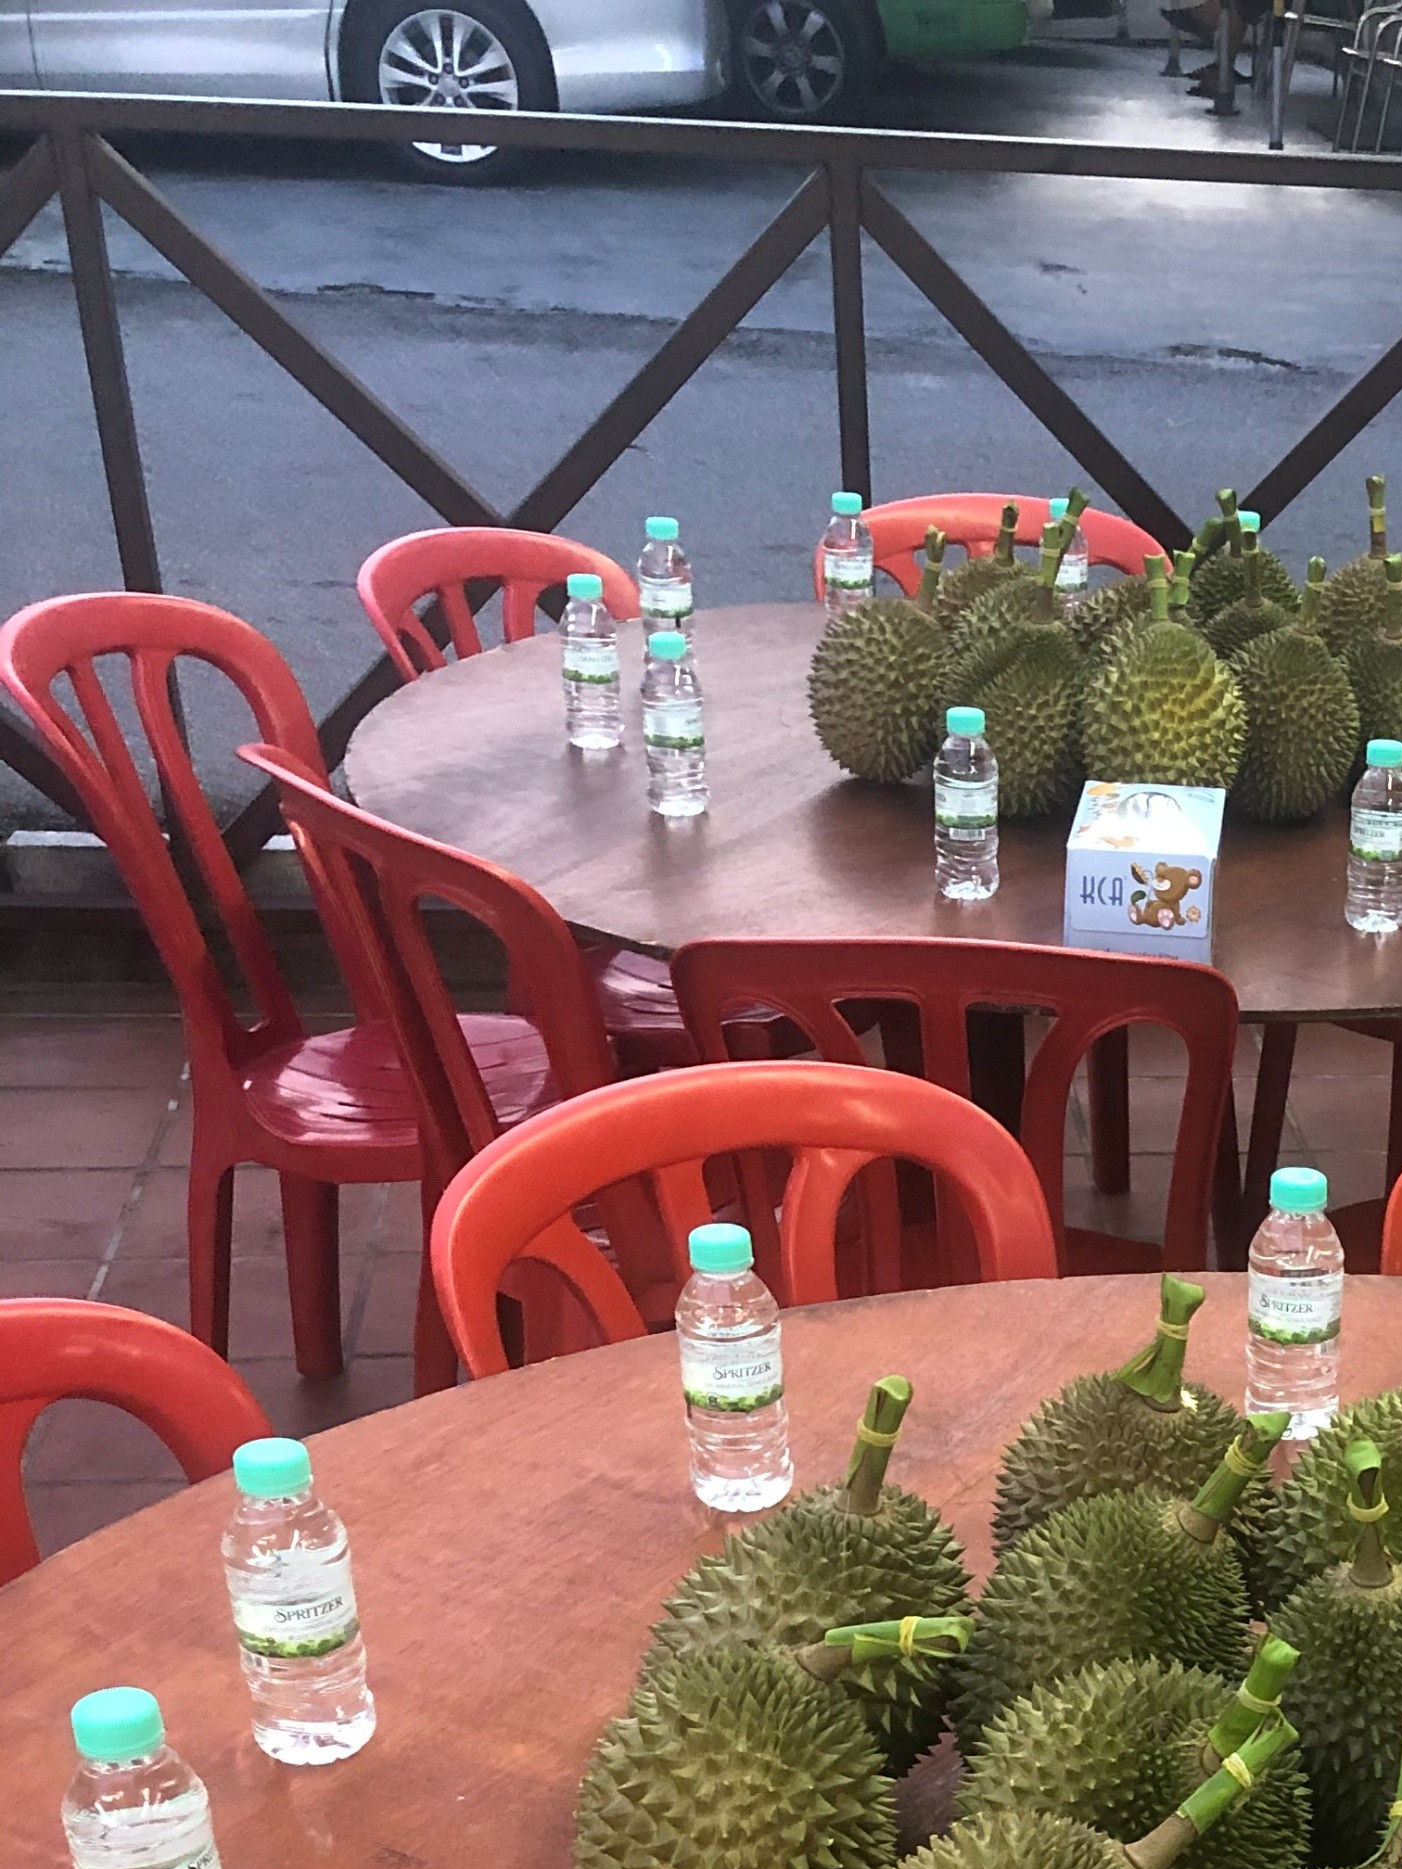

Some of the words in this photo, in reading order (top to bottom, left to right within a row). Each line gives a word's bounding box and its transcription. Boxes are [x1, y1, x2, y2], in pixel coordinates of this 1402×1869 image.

[1079, 875, 1124, 907] KCA
[712, 1361, 772, 1381] SPRITZER
[274, 1595, 344, 1624] SPRITZER
